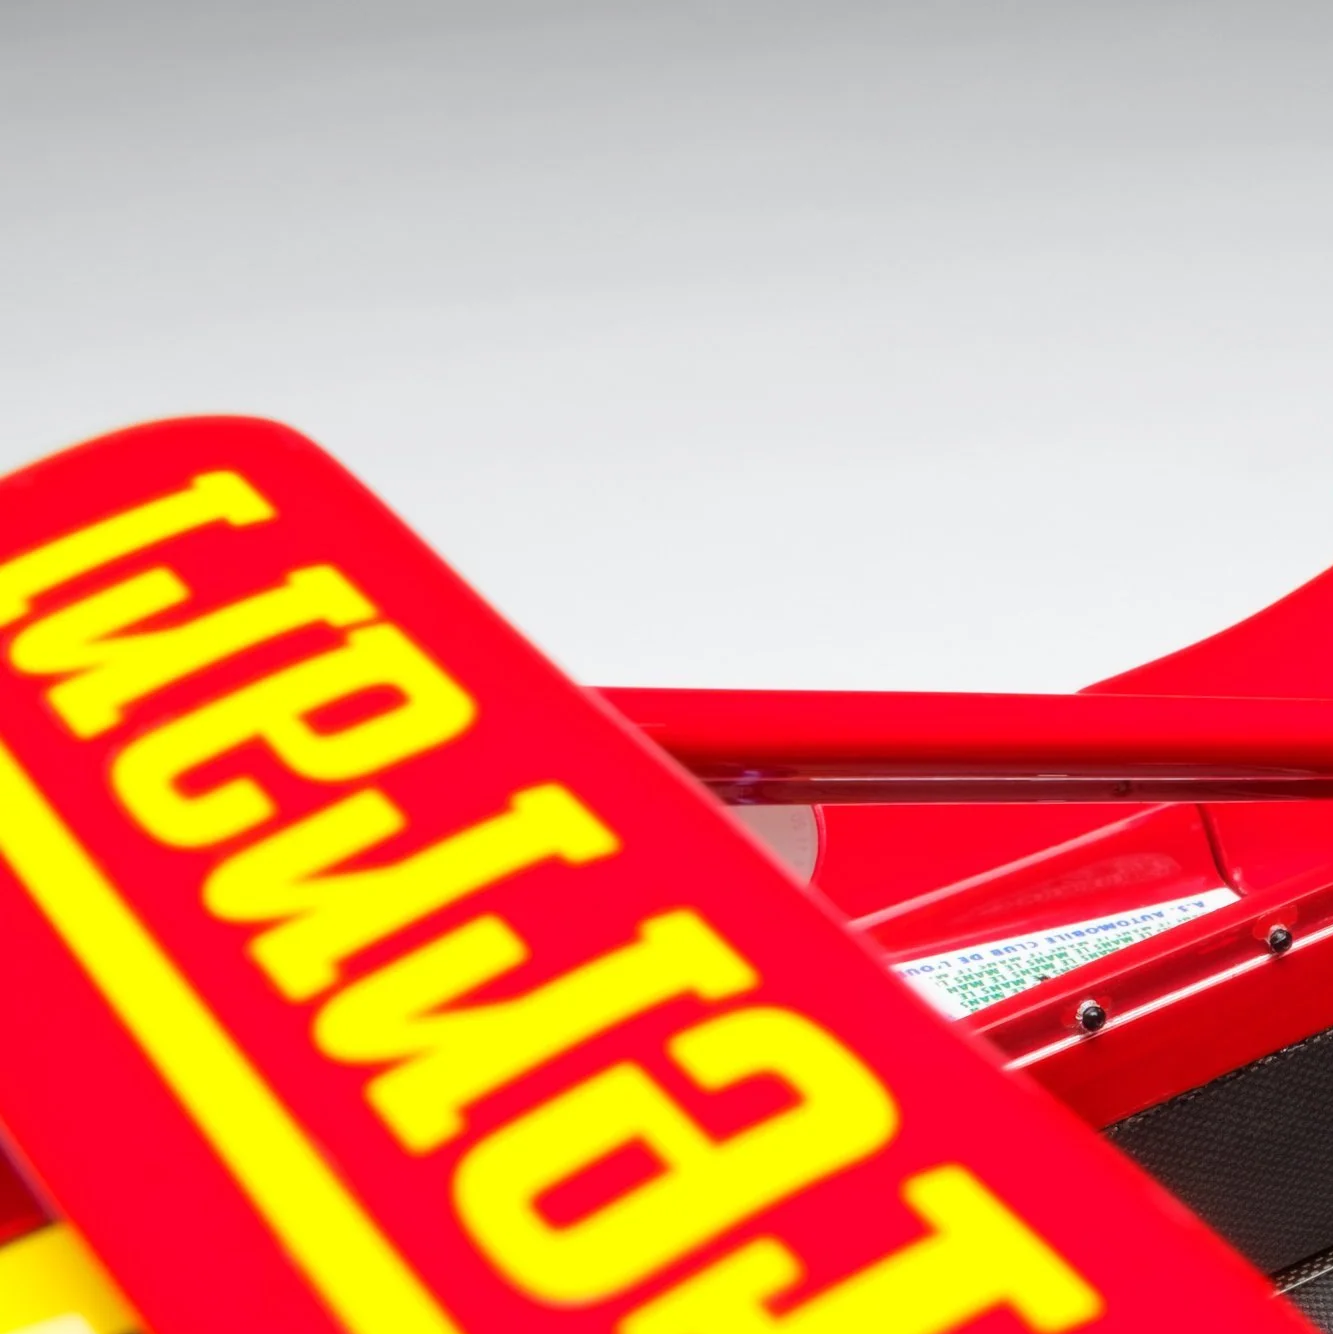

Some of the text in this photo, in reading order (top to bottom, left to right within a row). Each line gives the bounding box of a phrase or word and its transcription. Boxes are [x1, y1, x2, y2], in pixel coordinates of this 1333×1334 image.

[1045, 911, 1164, 945] AUTOMOBILE
[989, 940, 1038, 957] CLUB
[957, 953, 981, 965] DE
